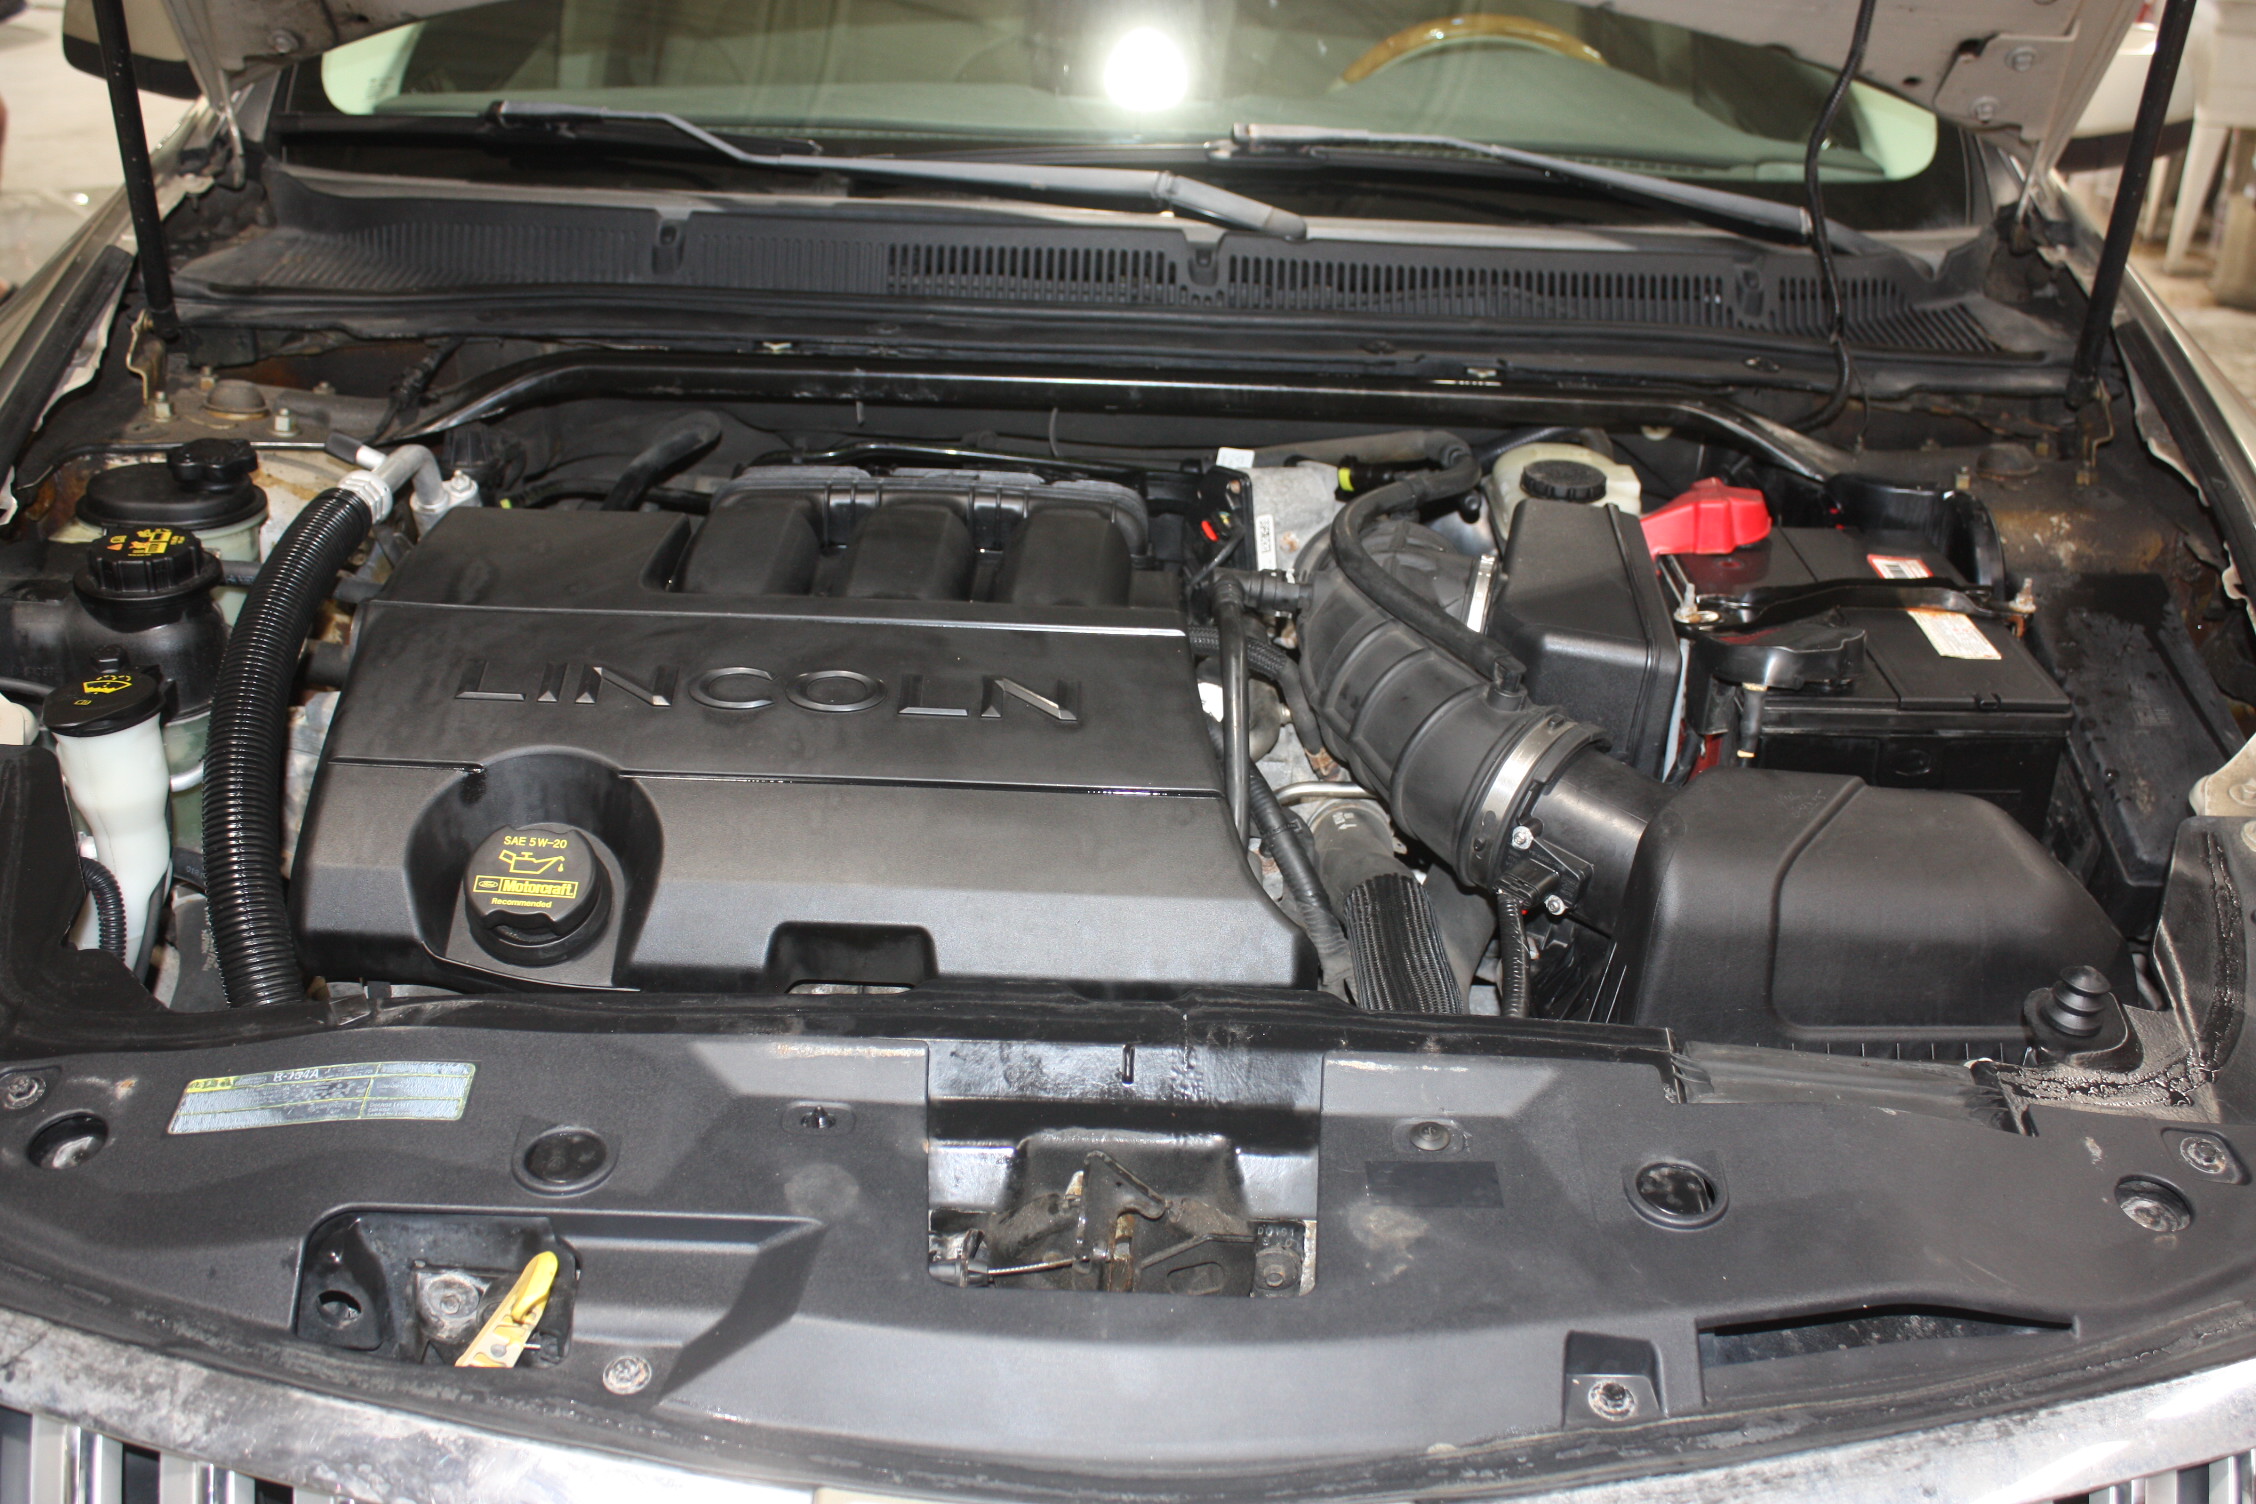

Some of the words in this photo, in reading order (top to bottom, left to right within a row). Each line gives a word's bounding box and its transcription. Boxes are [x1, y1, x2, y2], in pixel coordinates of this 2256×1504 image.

[455, 659, 1081, 722] LINCOLN
[503, 835, 527, 847] SAE
[529, 836, 568, 849] 5W-20
[491, 897, 553, 909] Recommended
